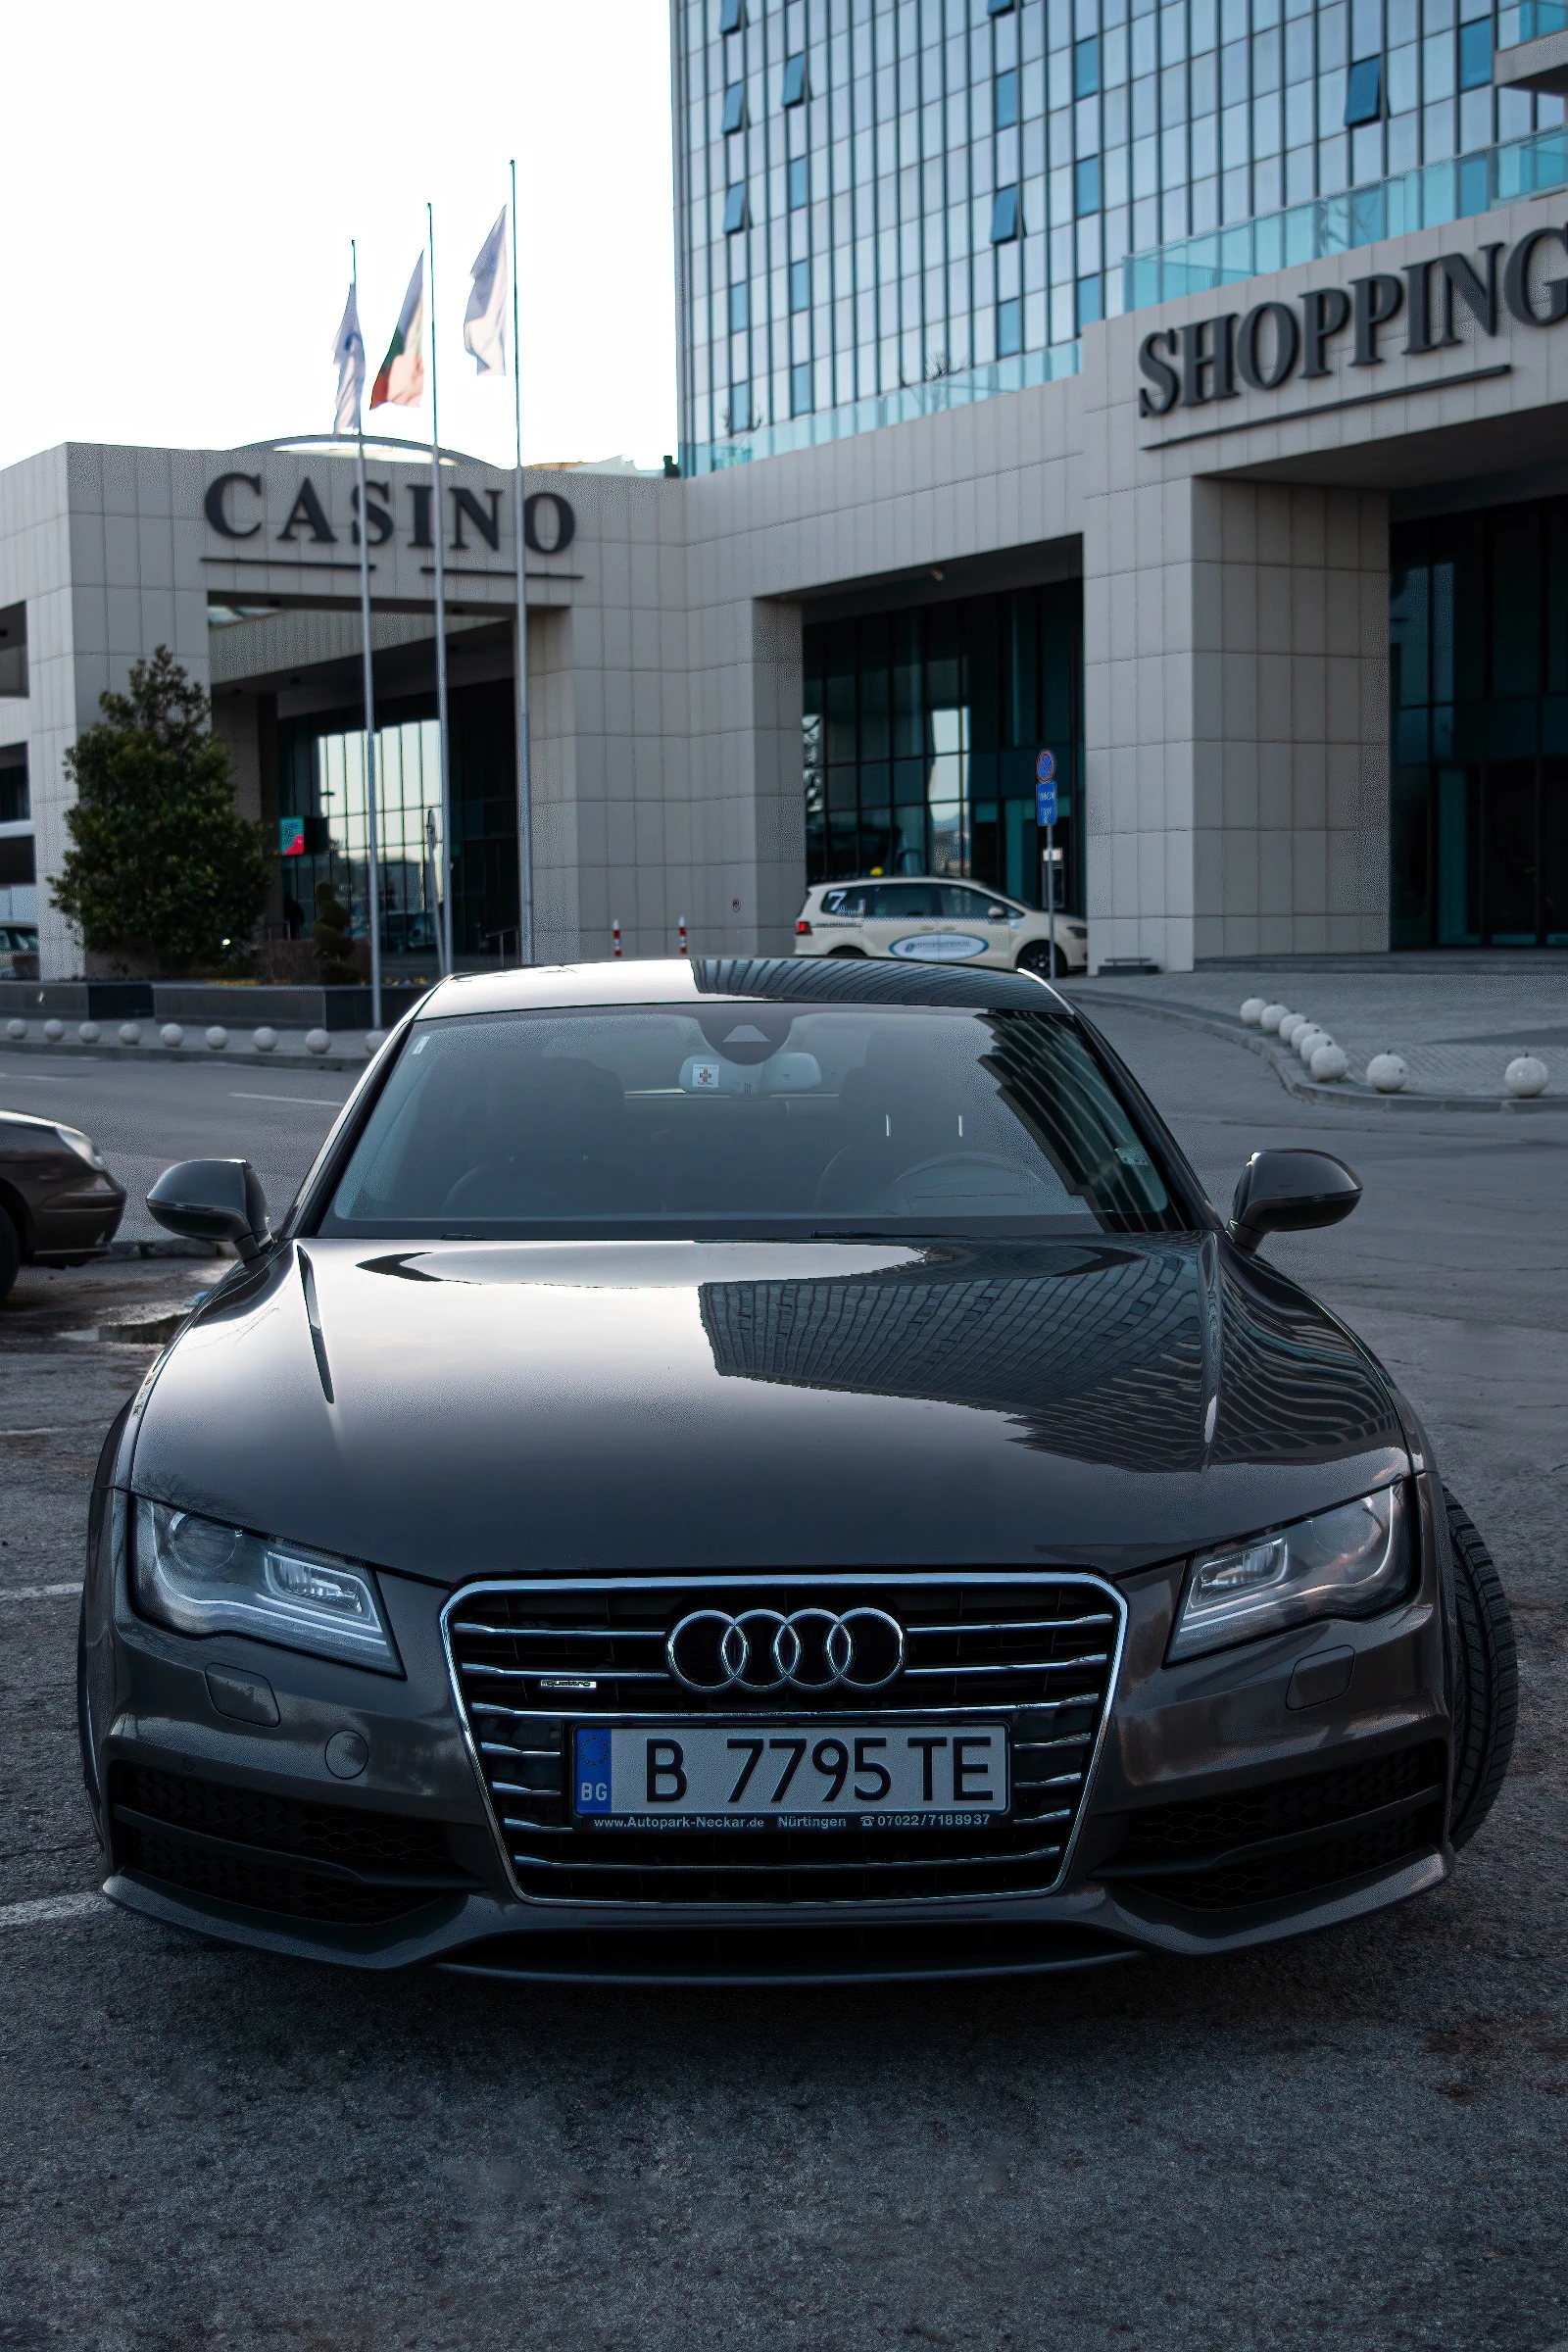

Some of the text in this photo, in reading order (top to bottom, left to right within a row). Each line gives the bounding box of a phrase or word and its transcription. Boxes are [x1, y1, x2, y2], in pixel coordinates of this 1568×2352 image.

[1138, 221, 1568, 418] SHOPPING
[204, 472, 576, 555] CASINO
[581, 1782, 608, 1802] BG
[646, 1737, 994, 1802] B 7795 TE
[594, 1816, 764, 1830] www.Autopark-Neckar.de
[777, 1815, 847, 1829] Nürtingen
